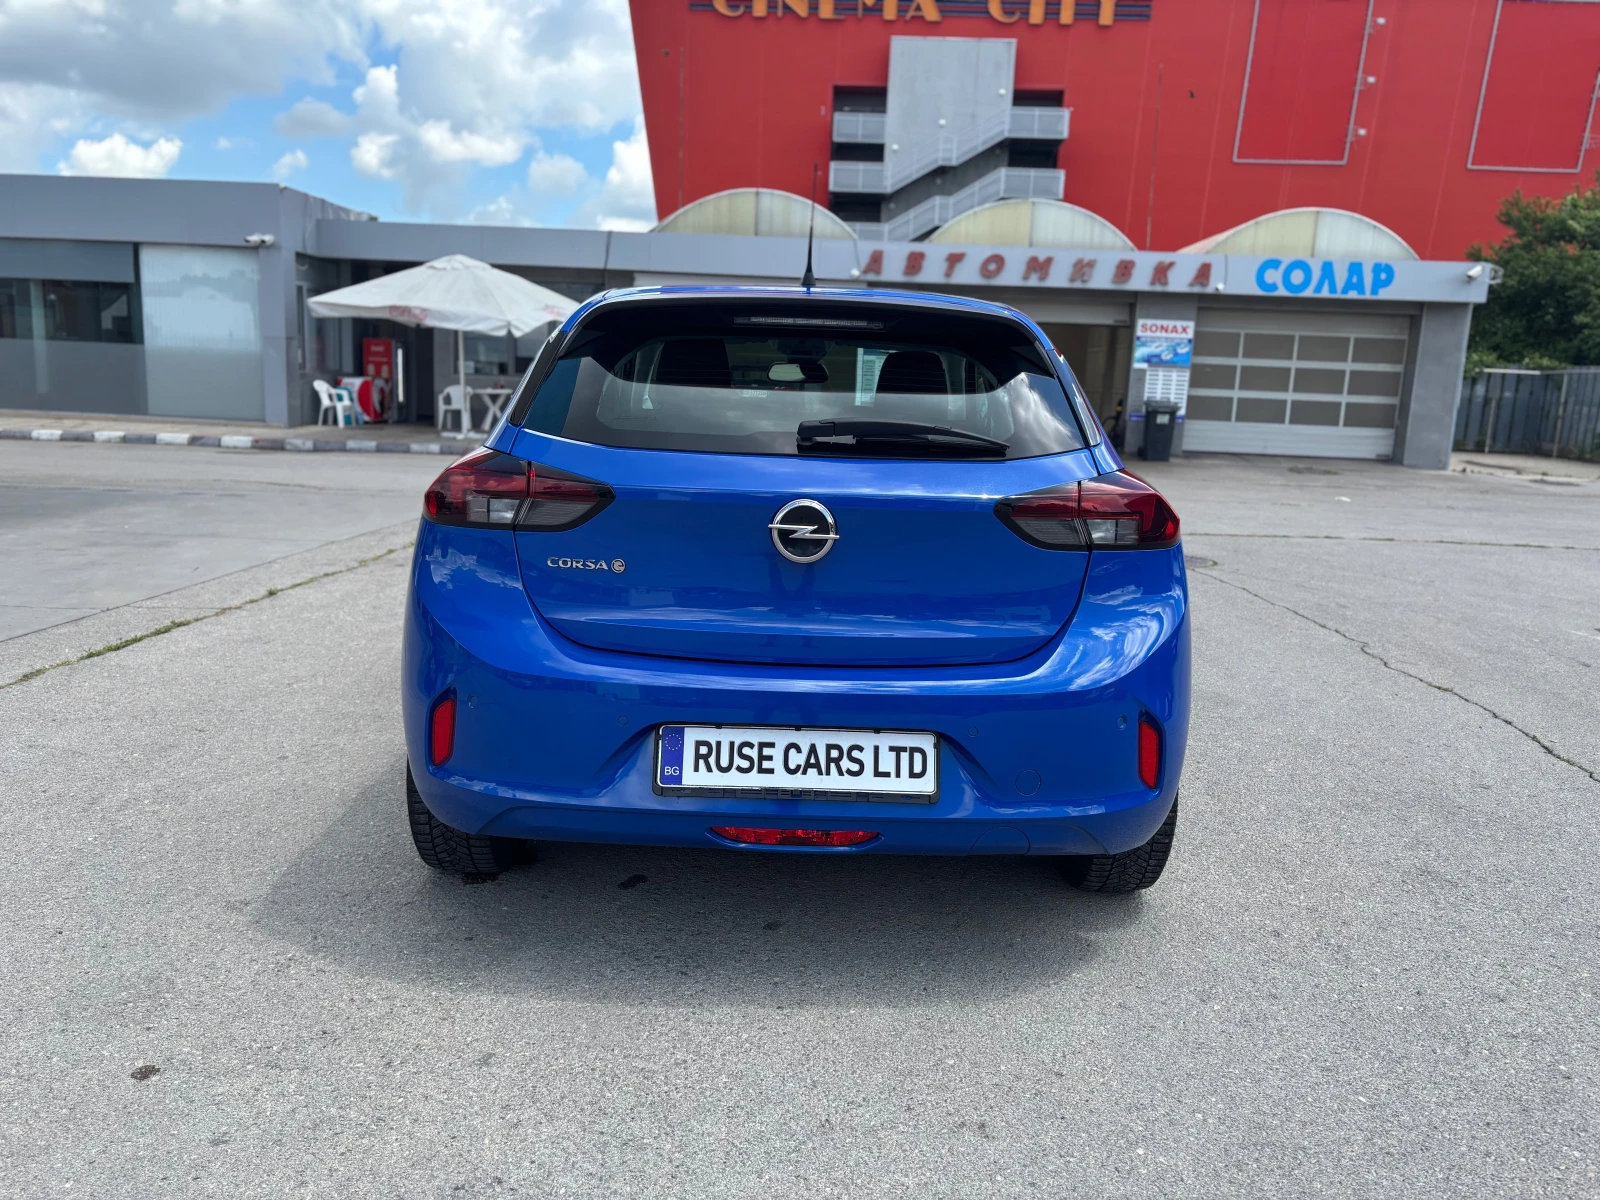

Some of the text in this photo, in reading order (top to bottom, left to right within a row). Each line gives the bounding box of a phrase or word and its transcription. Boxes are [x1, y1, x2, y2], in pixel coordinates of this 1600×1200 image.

[862, 249, 1213, 287] АВТОМИВКА
[1255, 258, 1395, 296] СОЛАР
[1140, 323, 1189, 335] SONAX
[547, 557, 608, 570] CORSA
[664, 766, 680, 776] BG
[693, 739, 928, 779] RUSE CARS LTD
